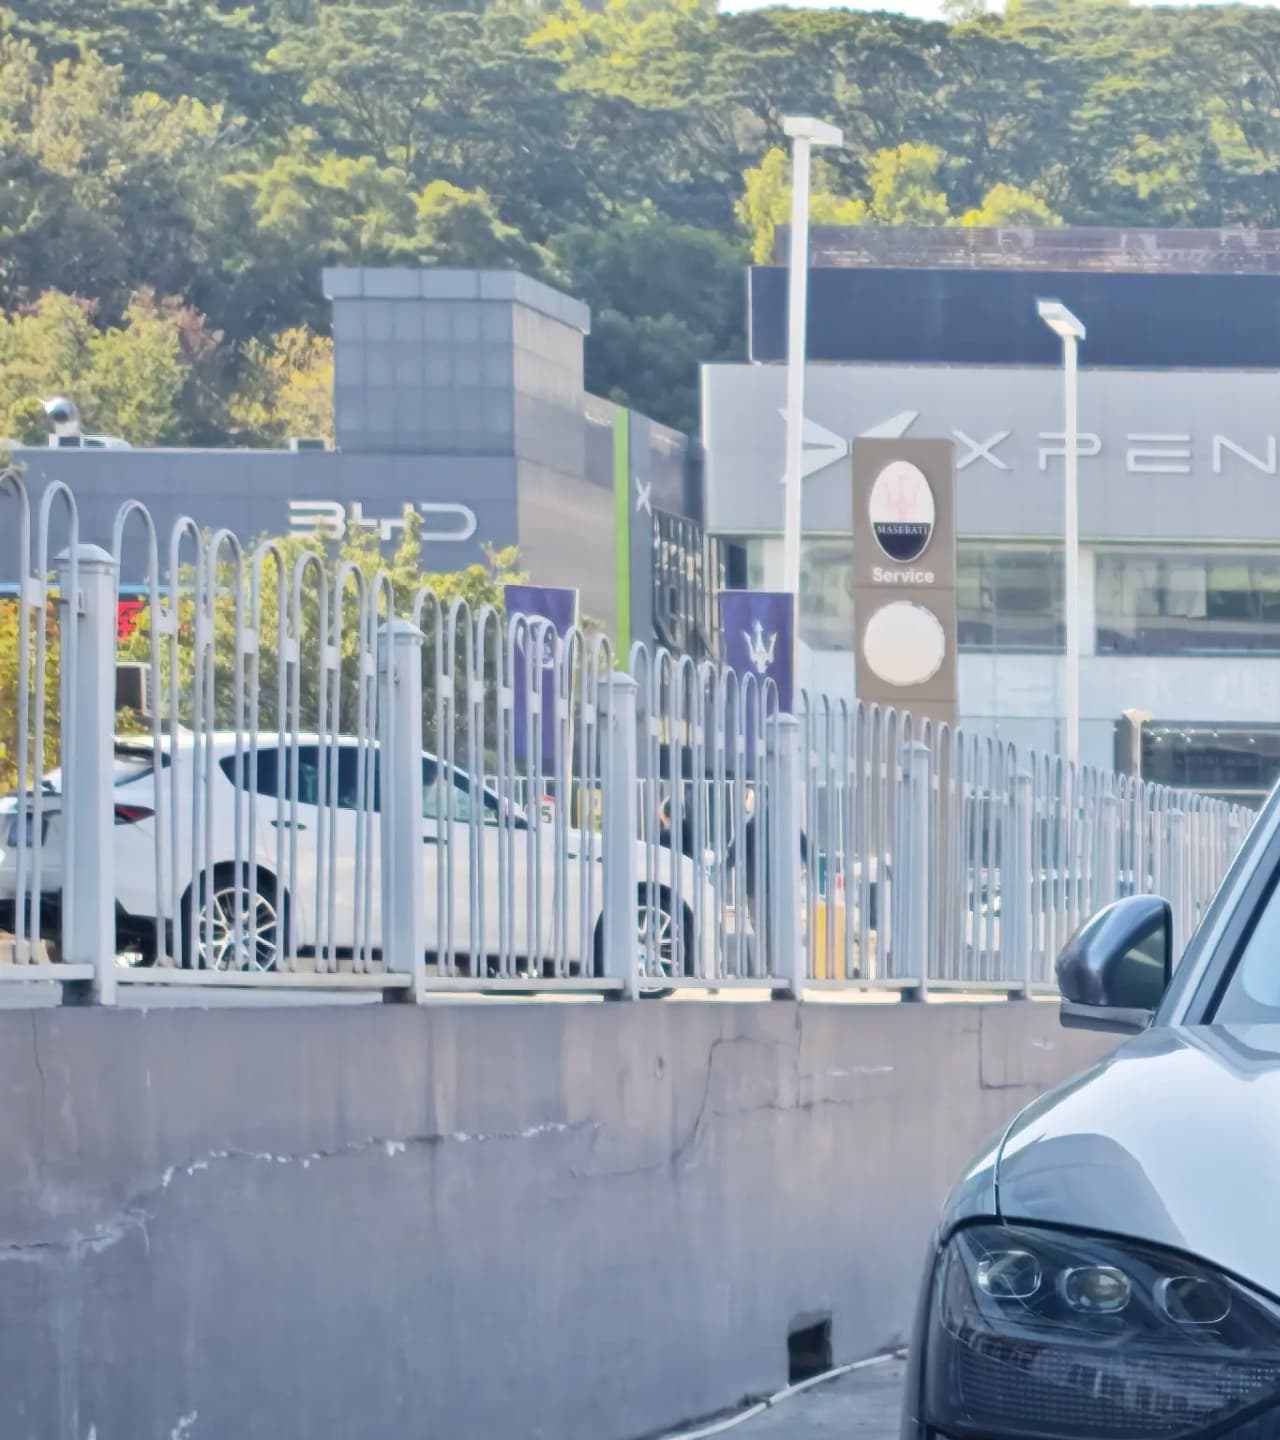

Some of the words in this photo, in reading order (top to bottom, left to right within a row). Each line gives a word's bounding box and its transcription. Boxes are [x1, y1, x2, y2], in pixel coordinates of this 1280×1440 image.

[288, 500, 476, 541] BYD
[877, 524, 929, 536] MASERATI
[872, 567, 935, 584] Service
